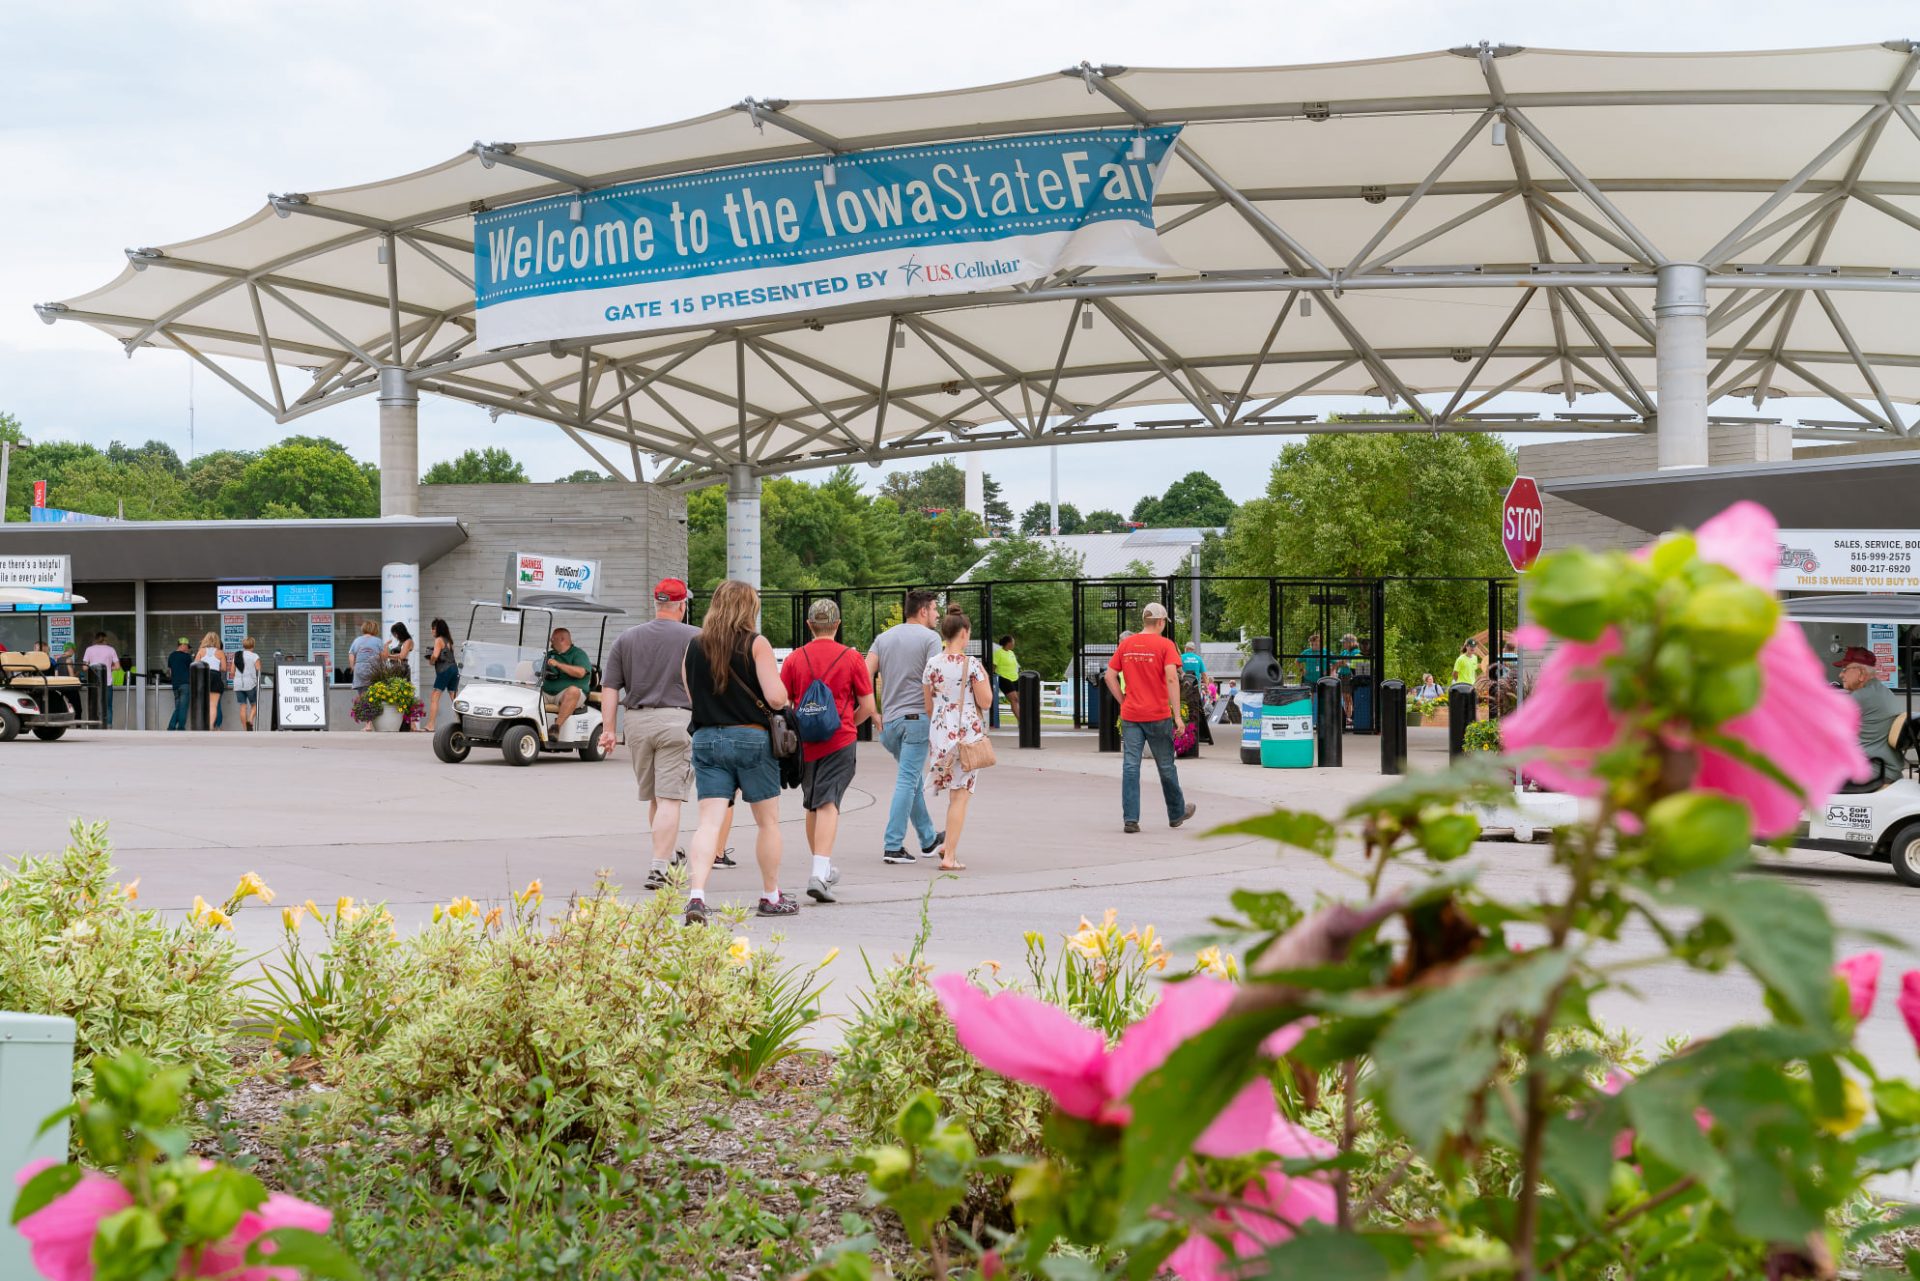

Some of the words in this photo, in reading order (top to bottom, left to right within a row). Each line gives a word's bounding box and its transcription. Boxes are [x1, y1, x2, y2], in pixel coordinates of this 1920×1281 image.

[488, 215, 655, 284] Welcome
[669, 200, 709, 256] to
[723, 187, 800, 249] the
[604, 300, 661, 322] GATE
[670, 296, 694, 315] 15
[700, 276, 848, 311] PRESENTED
[855, 269, 888, 290] BY
[925, 263, 954, 283] U.S.
[954, 257, 1021, 280] Cellular
[1505, 506, 1541, 542] STOP
[1834, 540, 1863, 550] SALES,
[1865, 540, 1903, 550] SERVICE,
[1850, 552, 1911, 561] 515-999-2575
[8, 558, 31, 569] there's
[33, 561, 37, 569] a
[39, 558, 61, 571] helpful
[1850, 564, 1911, 573] 800-217-6920
[19, 574, 36, 585] every
[558, 578, 583, 591] Triple
[1797, 575, 1818, 585] THIS
[1819, 575, 1828, 585] IS
[1831, 575, 1864, 585] WHERE
[1866, 576, 1884, 586] YOU
[1886, 576, 1905, 586] BUY
[244, 594, 273, 603] Cellular
[285, 668, 316, 676] PURCHASE
